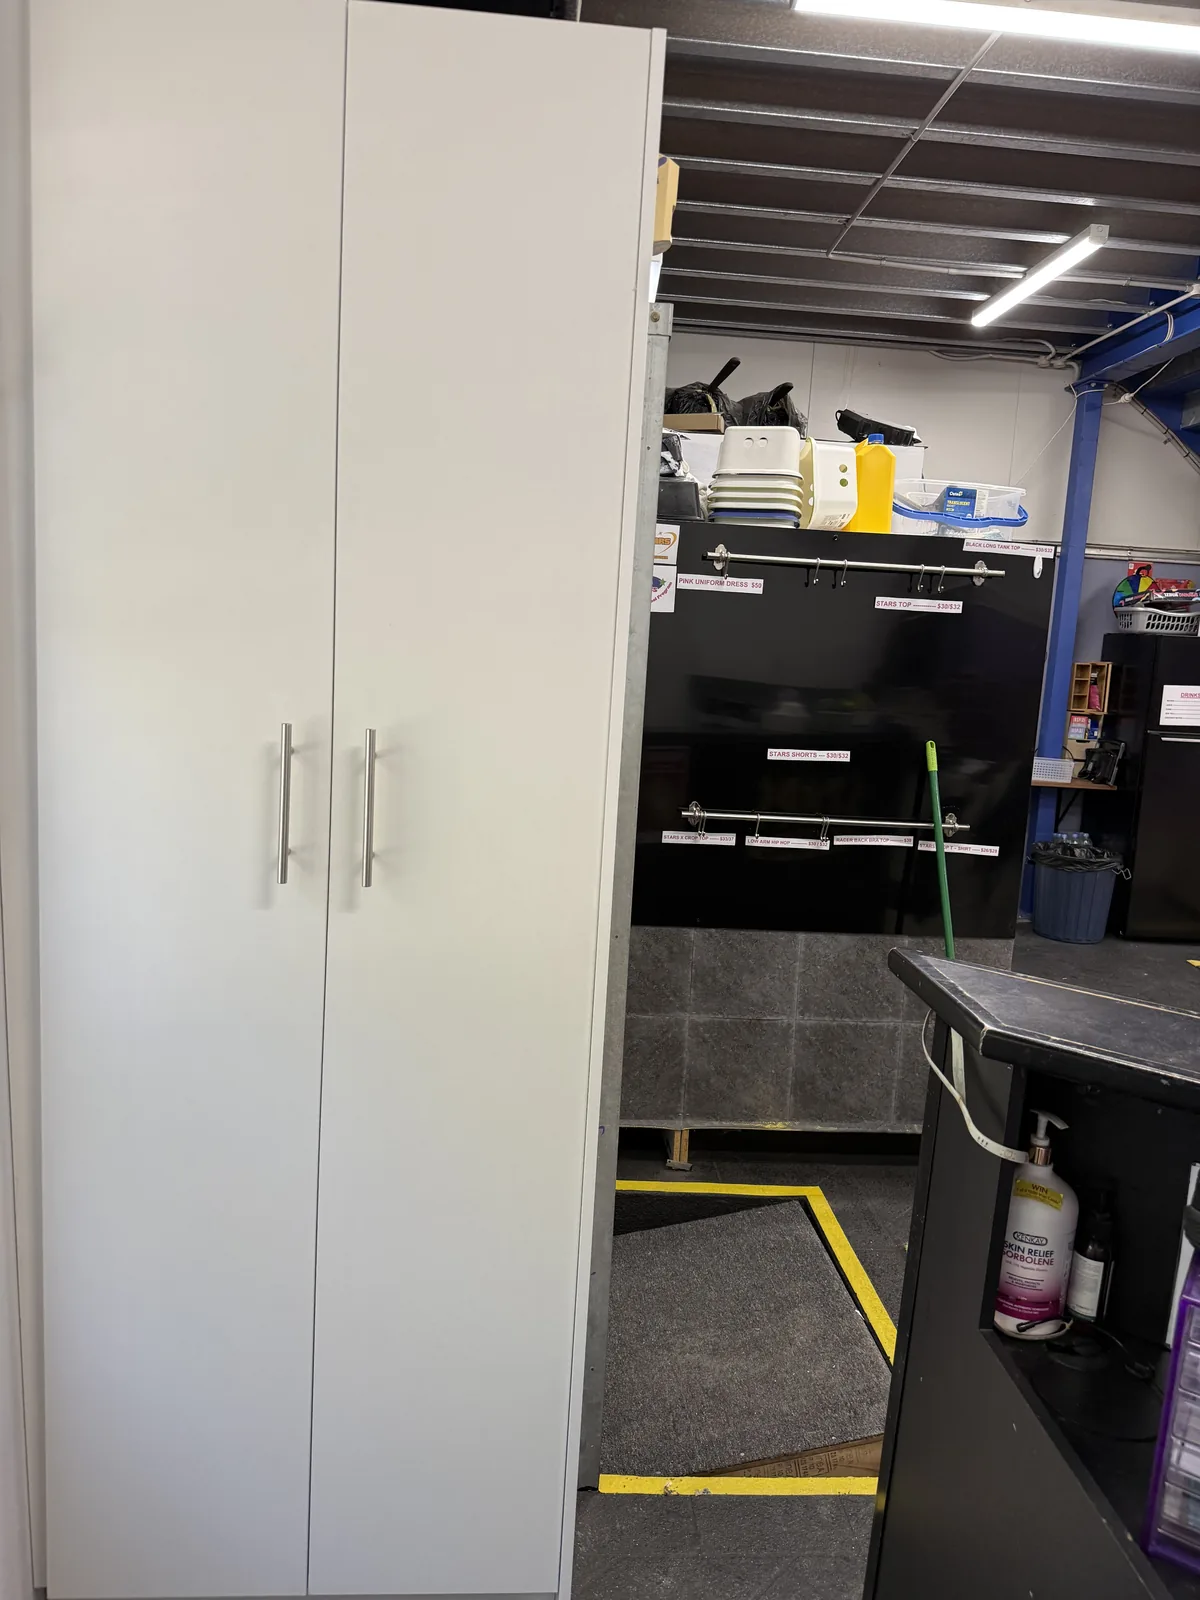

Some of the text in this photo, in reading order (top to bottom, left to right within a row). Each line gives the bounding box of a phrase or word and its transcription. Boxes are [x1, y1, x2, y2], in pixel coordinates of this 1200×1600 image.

[678, 577, 694, 585] PINK
[695, 579, 725, 587] UNIFORM
[876, 600, 897, 608] STARS
[791, 751, 817, 759] SHORTS
[1031, 1183, 1048, 1195] WIN
[1016, 1232, 1044, 1245] KENKAY
[1003, 1240, 1055, 1258] SKIN RELIEF
[1002, 1250, 1055, 1266] SORBOLENE
